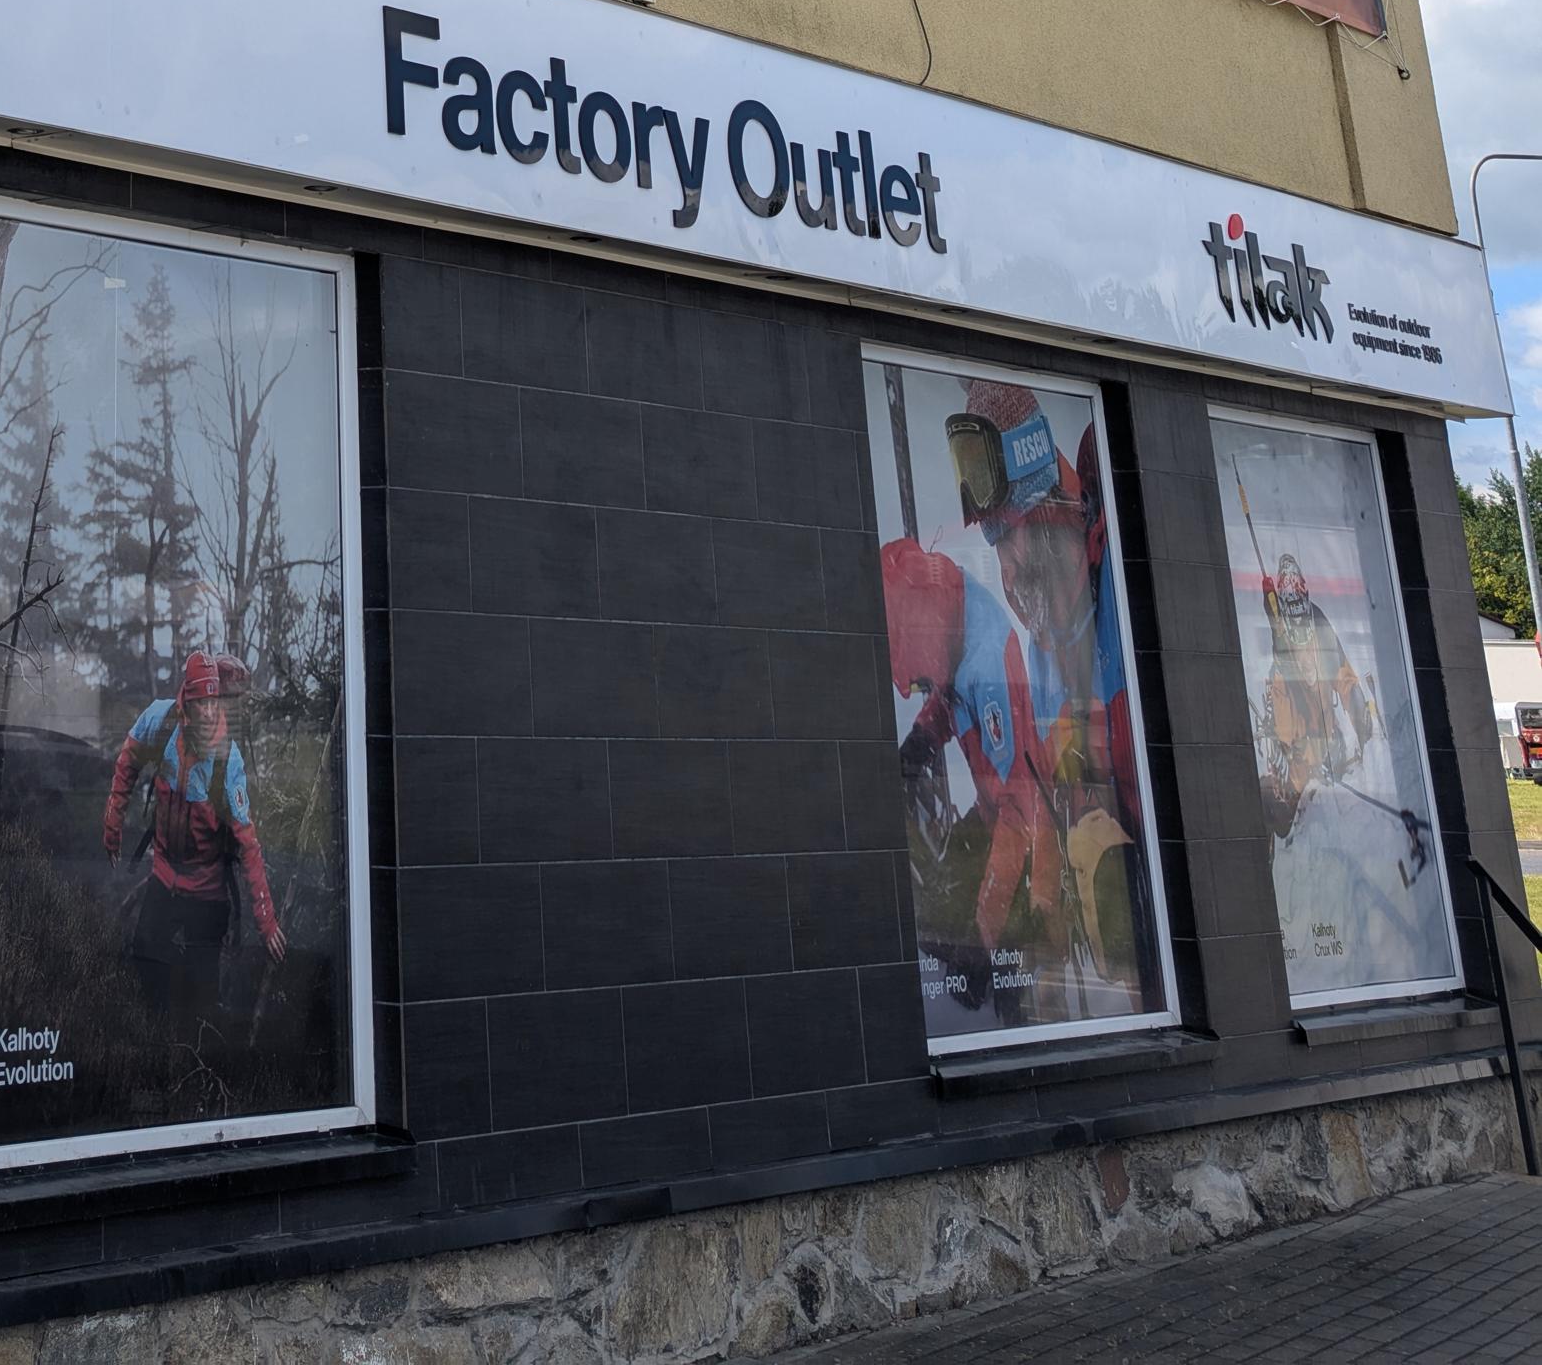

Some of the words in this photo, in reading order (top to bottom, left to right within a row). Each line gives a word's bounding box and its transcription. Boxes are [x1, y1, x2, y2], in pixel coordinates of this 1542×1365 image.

[382, 5, 711, 229] Factory
[727, 99, 948, 254] Outlet
[1201, 213, 1335, 344] tilak
[1347, 303, 1388, 329] Evolution
[1388, 314, 1398, 331] of
[1399, 318, 1431, 339] outdoor
[1352, 331, 1400, 354] equipment
[1399, 340, 1422, 360] since
[1421, 344, 1443, 365] 1986
[1310, 922, 1337, 938] Kalhoty
[990, 948, 1024, 968] Kalhoty
[945, 974, 967, 994] PRO
[992, 970, 1034, 989] Evolution
